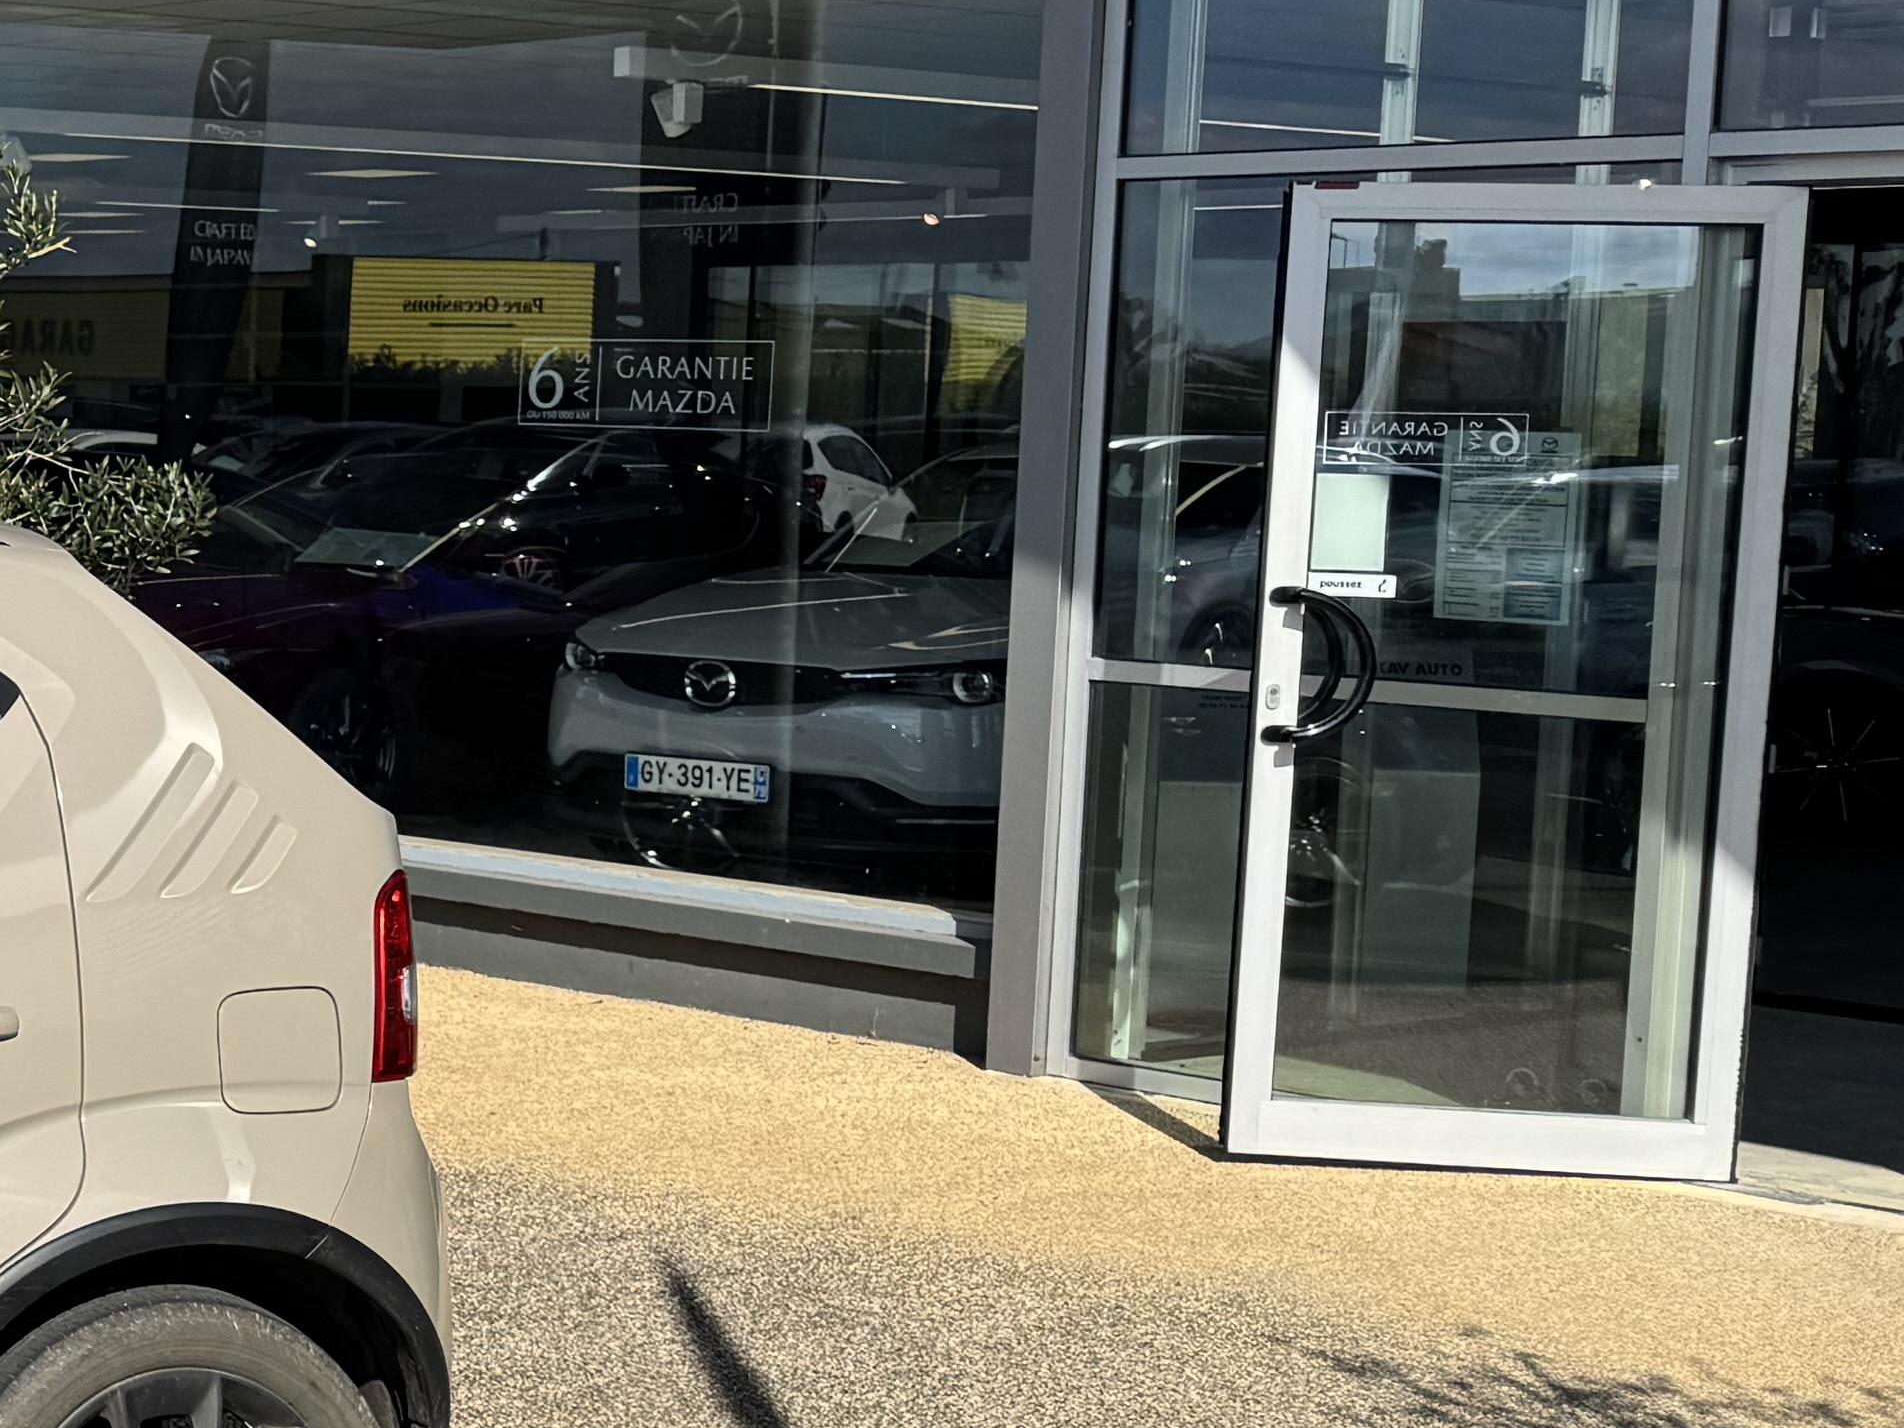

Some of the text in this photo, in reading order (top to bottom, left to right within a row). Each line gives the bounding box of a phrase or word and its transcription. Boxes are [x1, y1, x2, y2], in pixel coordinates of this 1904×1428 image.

[528, 346, 591, 409] 6 ANS
[616, 355, 755, 381] GARANTIE
[629, 389, 736, 415] MAZDA
[1417, 664, 1463, 677] AUTO
[641, 760, 752, 793] GY-391-YE
